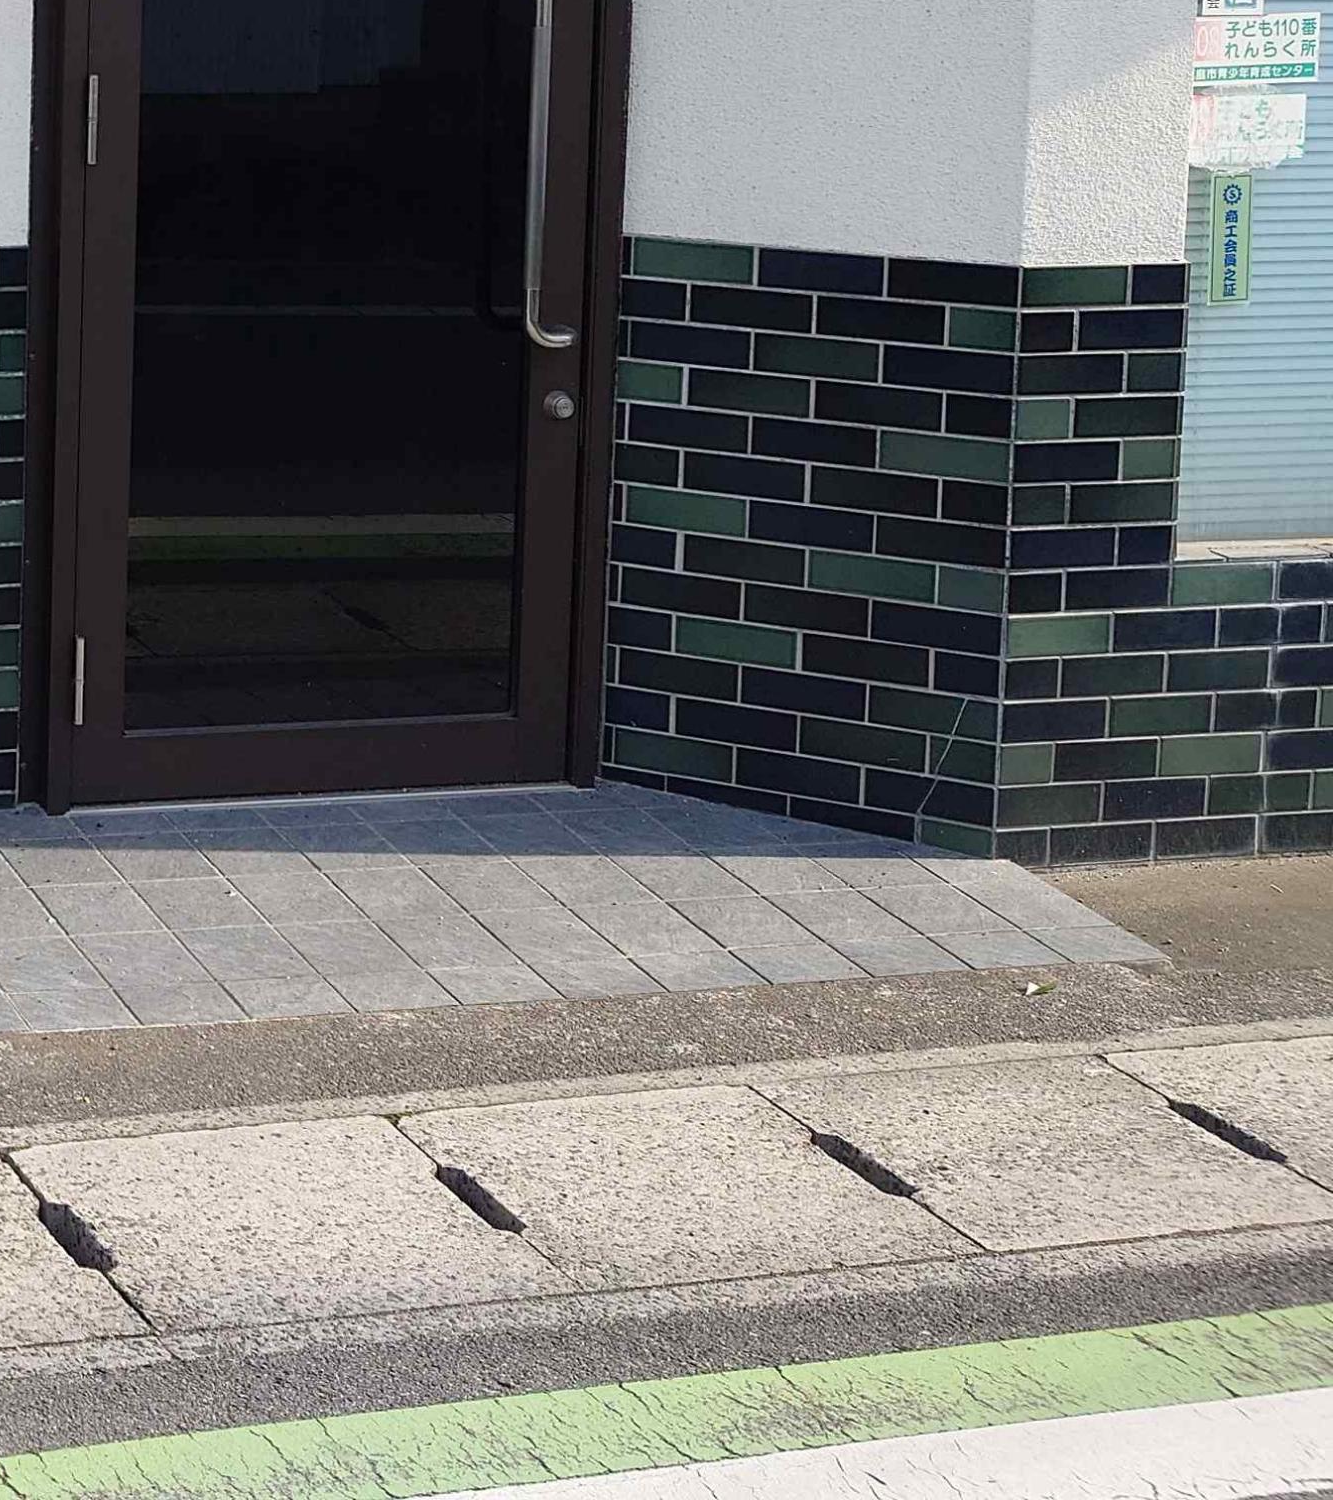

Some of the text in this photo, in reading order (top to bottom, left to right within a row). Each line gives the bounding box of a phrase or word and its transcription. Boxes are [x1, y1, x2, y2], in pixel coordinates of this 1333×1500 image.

[1225, 18, 1317, 38] 子ども110番
[1225, 39, 1316, 59] れんらく所
[1223, 209, 1238, 297] 商工会員之証
